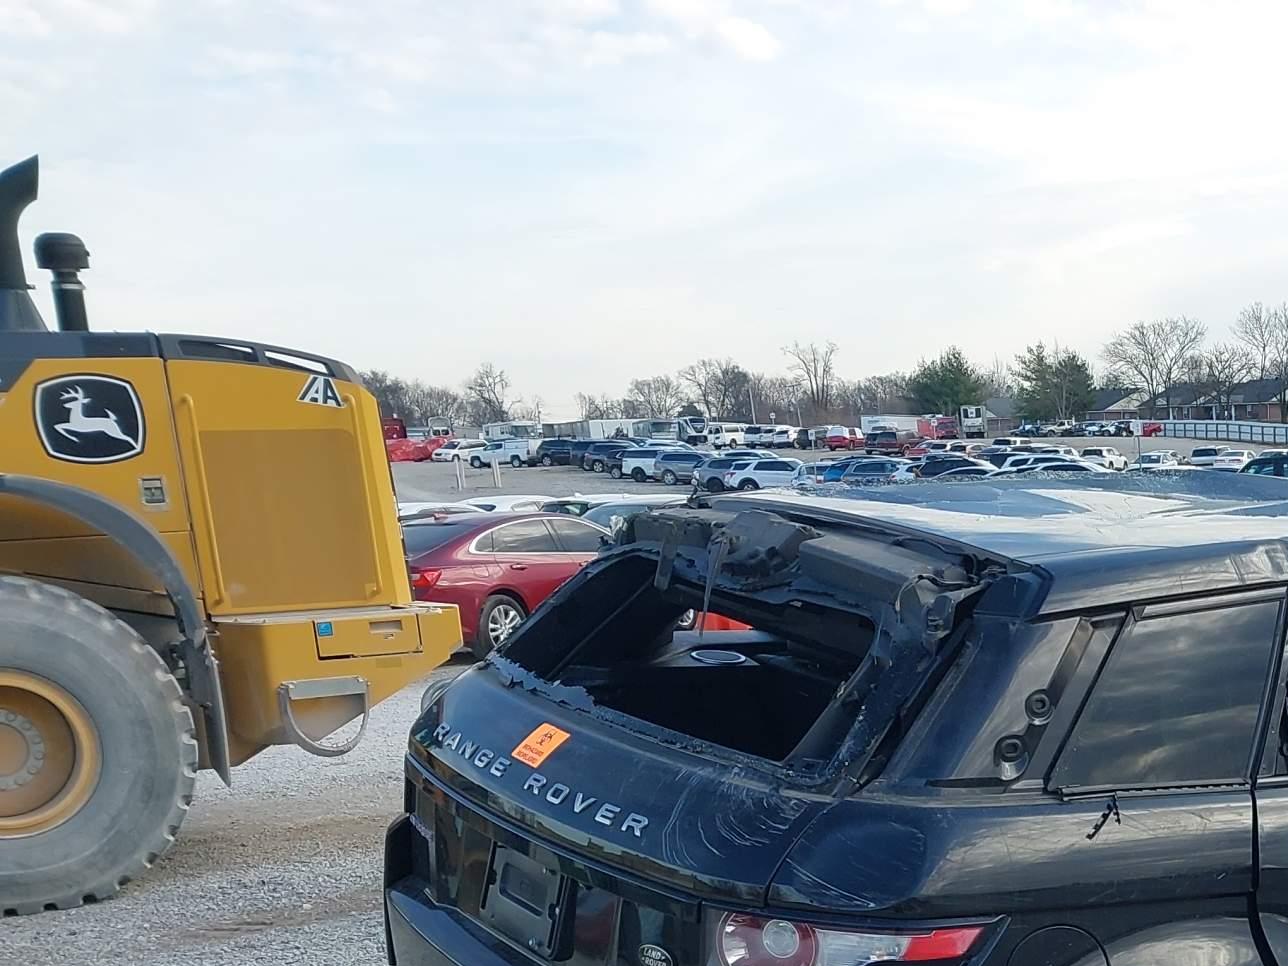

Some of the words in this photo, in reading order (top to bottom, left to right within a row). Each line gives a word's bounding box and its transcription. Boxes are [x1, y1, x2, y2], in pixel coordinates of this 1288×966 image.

[432, 721, 512, 778] RANGE
[523, 772, 649, 837] ROVER
[643, 947, 662, 960] LAND
